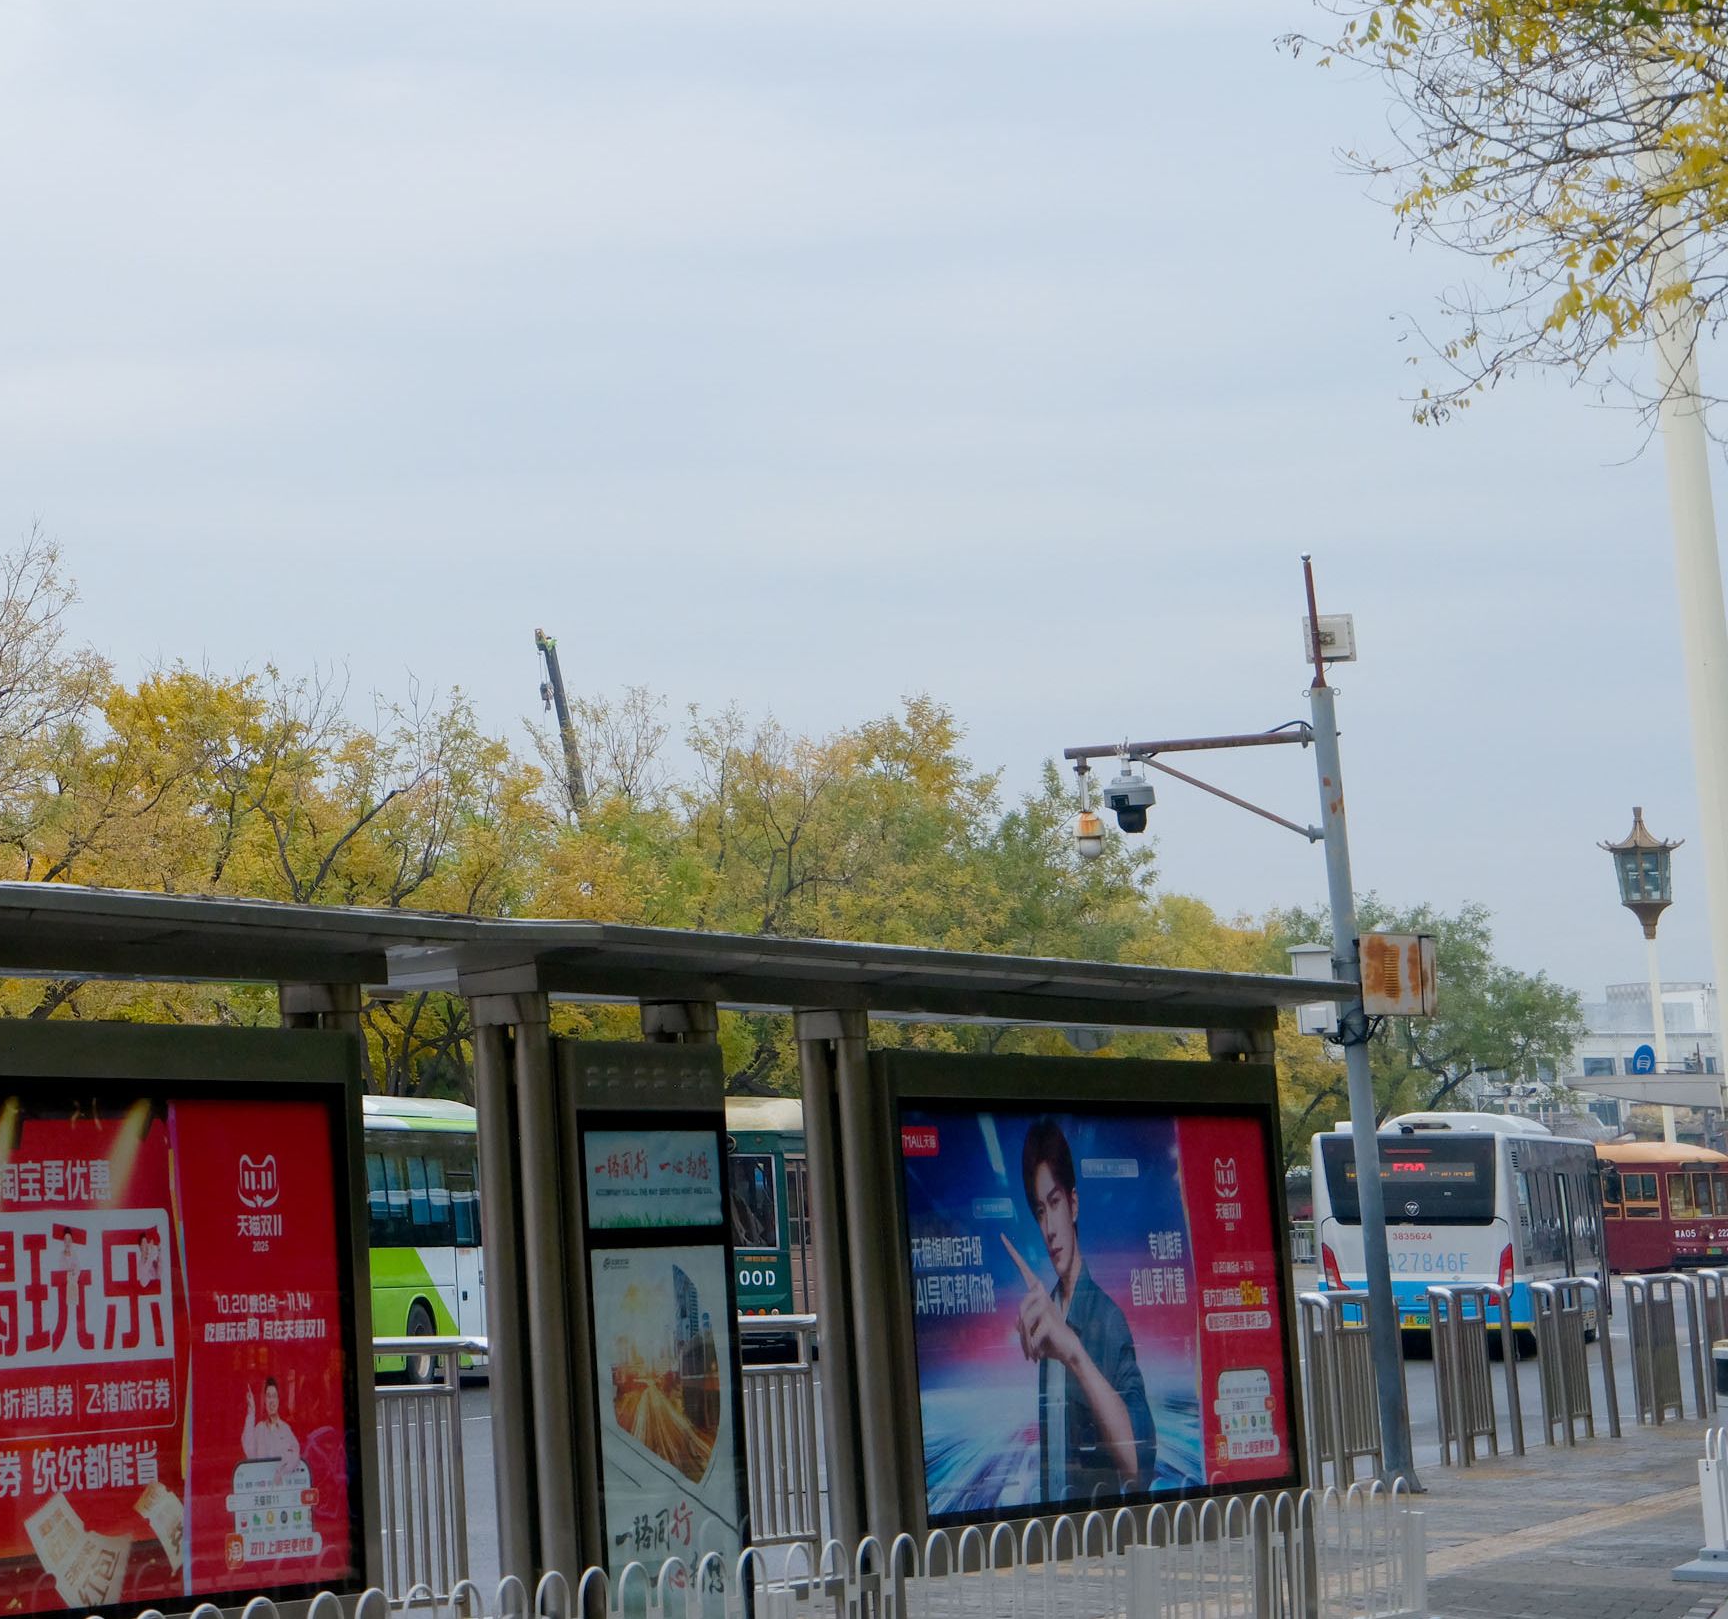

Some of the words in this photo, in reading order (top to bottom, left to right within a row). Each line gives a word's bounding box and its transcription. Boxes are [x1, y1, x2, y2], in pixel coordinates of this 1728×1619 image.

[237, 1214, 282, 1237] 天猫双11
[1131, 1267, 1187, 1306] 省心更优惠
[85, 1378, 171, 1414] 飞猪旅行券
[32, 1440, 159, 1495] 统统都能省
